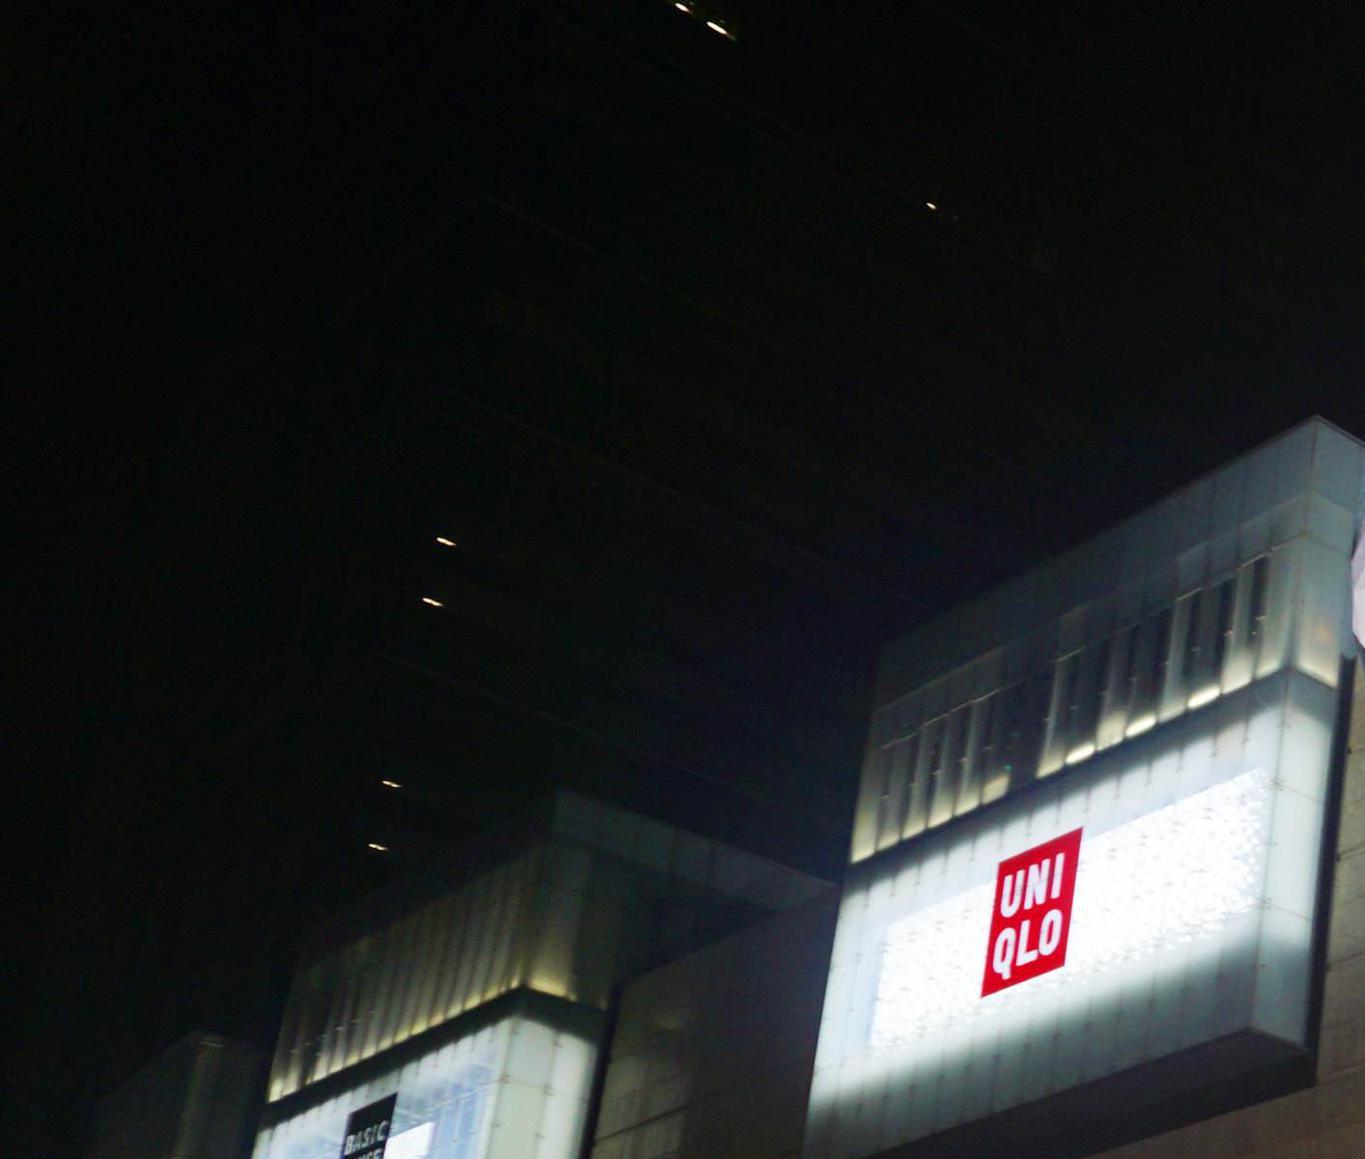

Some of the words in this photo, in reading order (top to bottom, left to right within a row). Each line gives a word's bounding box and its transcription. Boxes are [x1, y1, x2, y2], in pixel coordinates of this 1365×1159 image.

[1001, 853, 1065, 918] UNI
[993, 909, 1063, 980] QLO
[344, 1120, 389, 1156] BASIC
